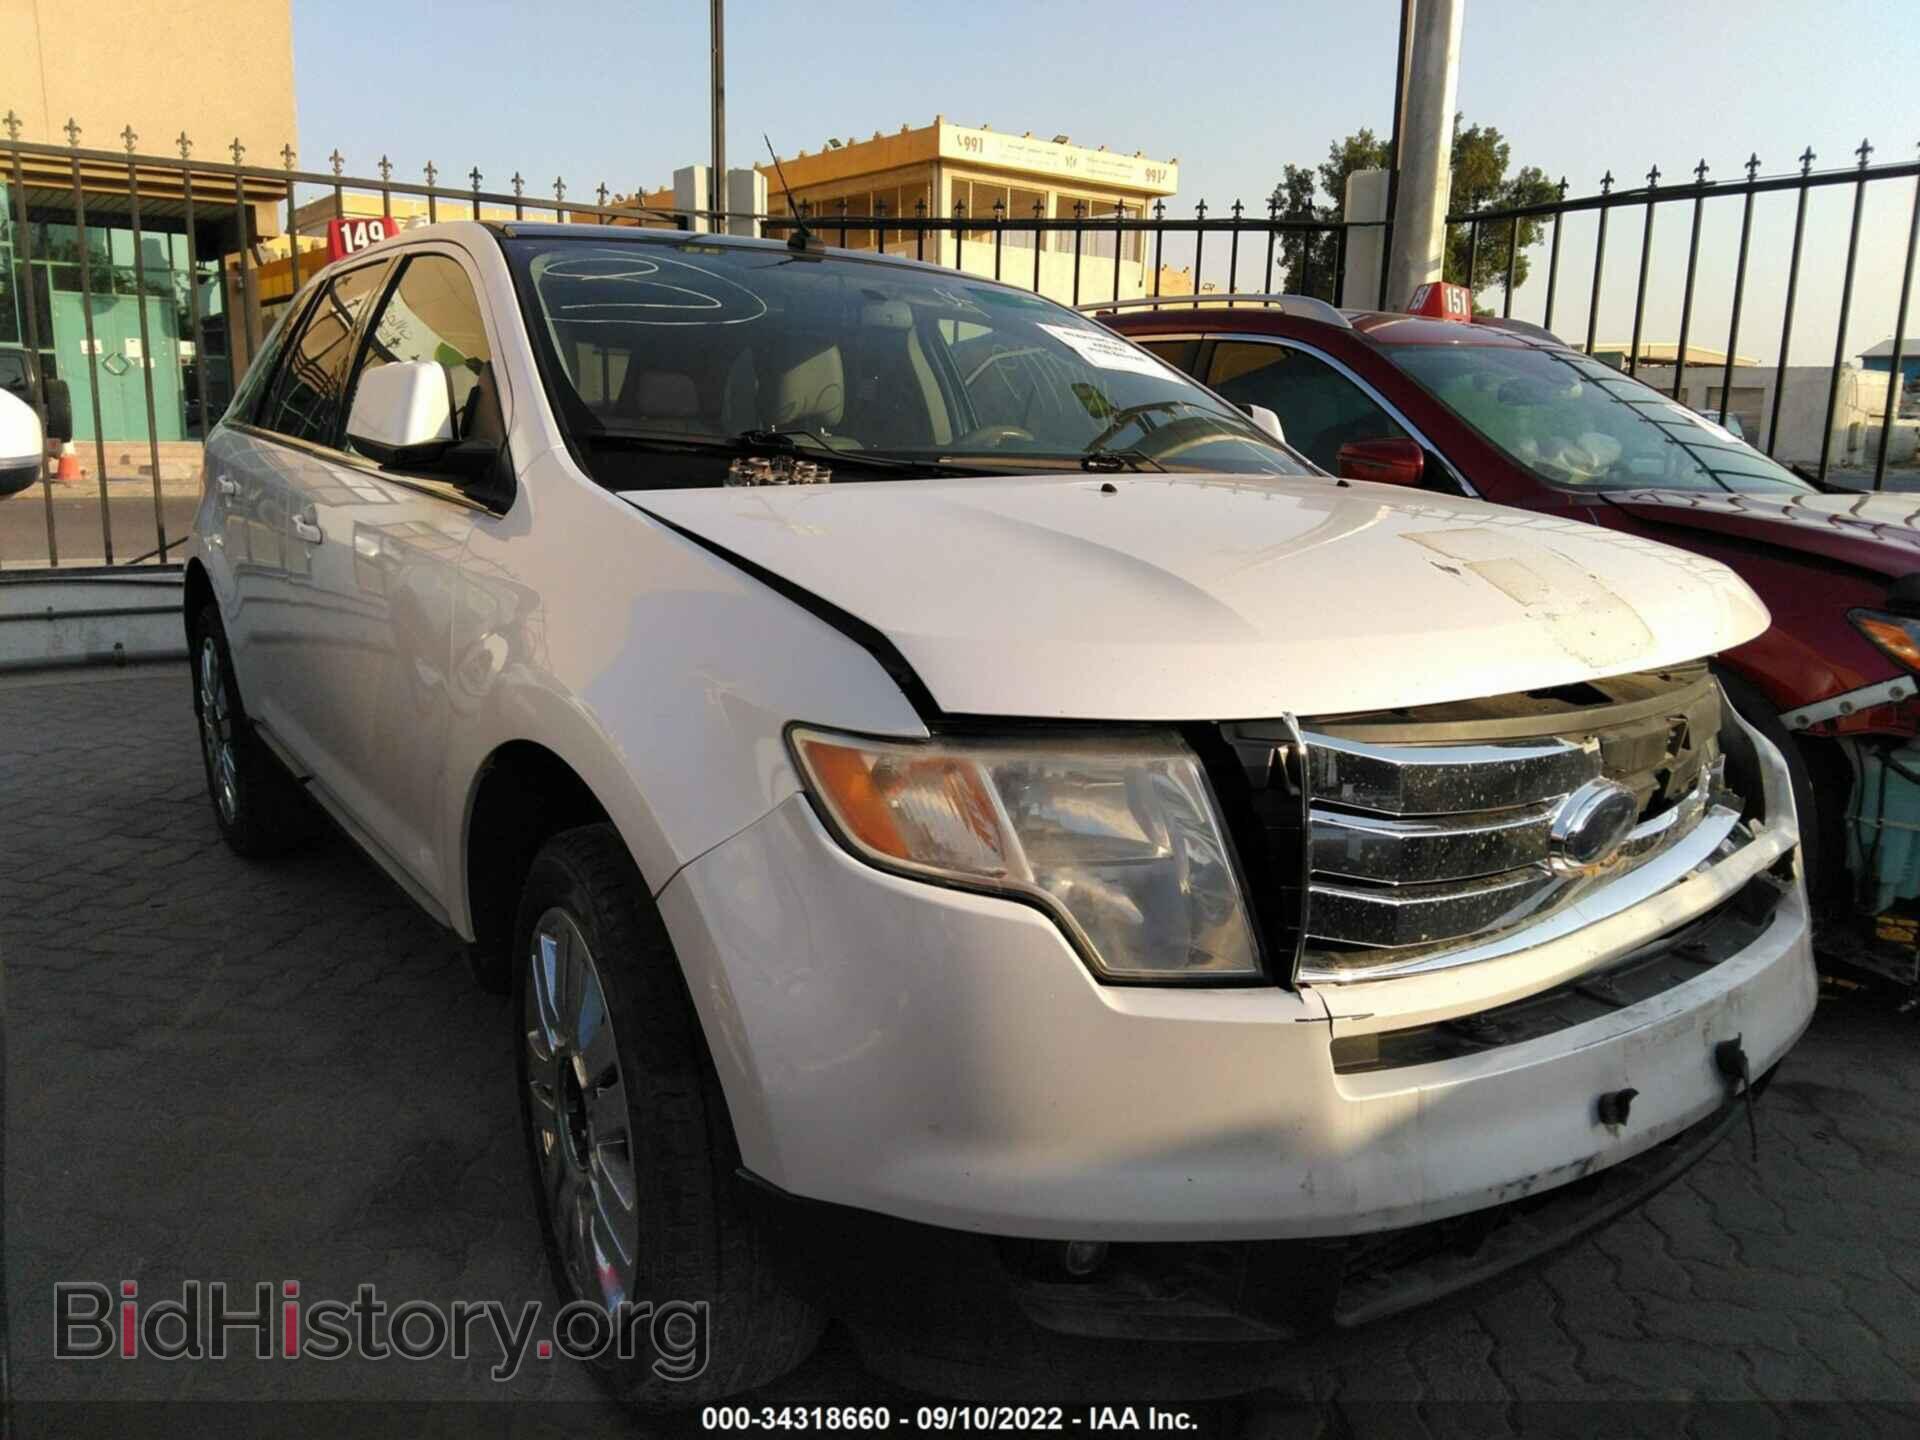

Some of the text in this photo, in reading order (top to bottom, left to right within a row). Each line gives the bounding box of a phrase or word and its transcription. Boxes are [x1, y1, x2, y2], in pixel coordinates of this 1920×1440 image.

[963, 135, 984, 153] 991
[340, 220, 385, 254] 149
[1446, 287, 1467, 316] 151
